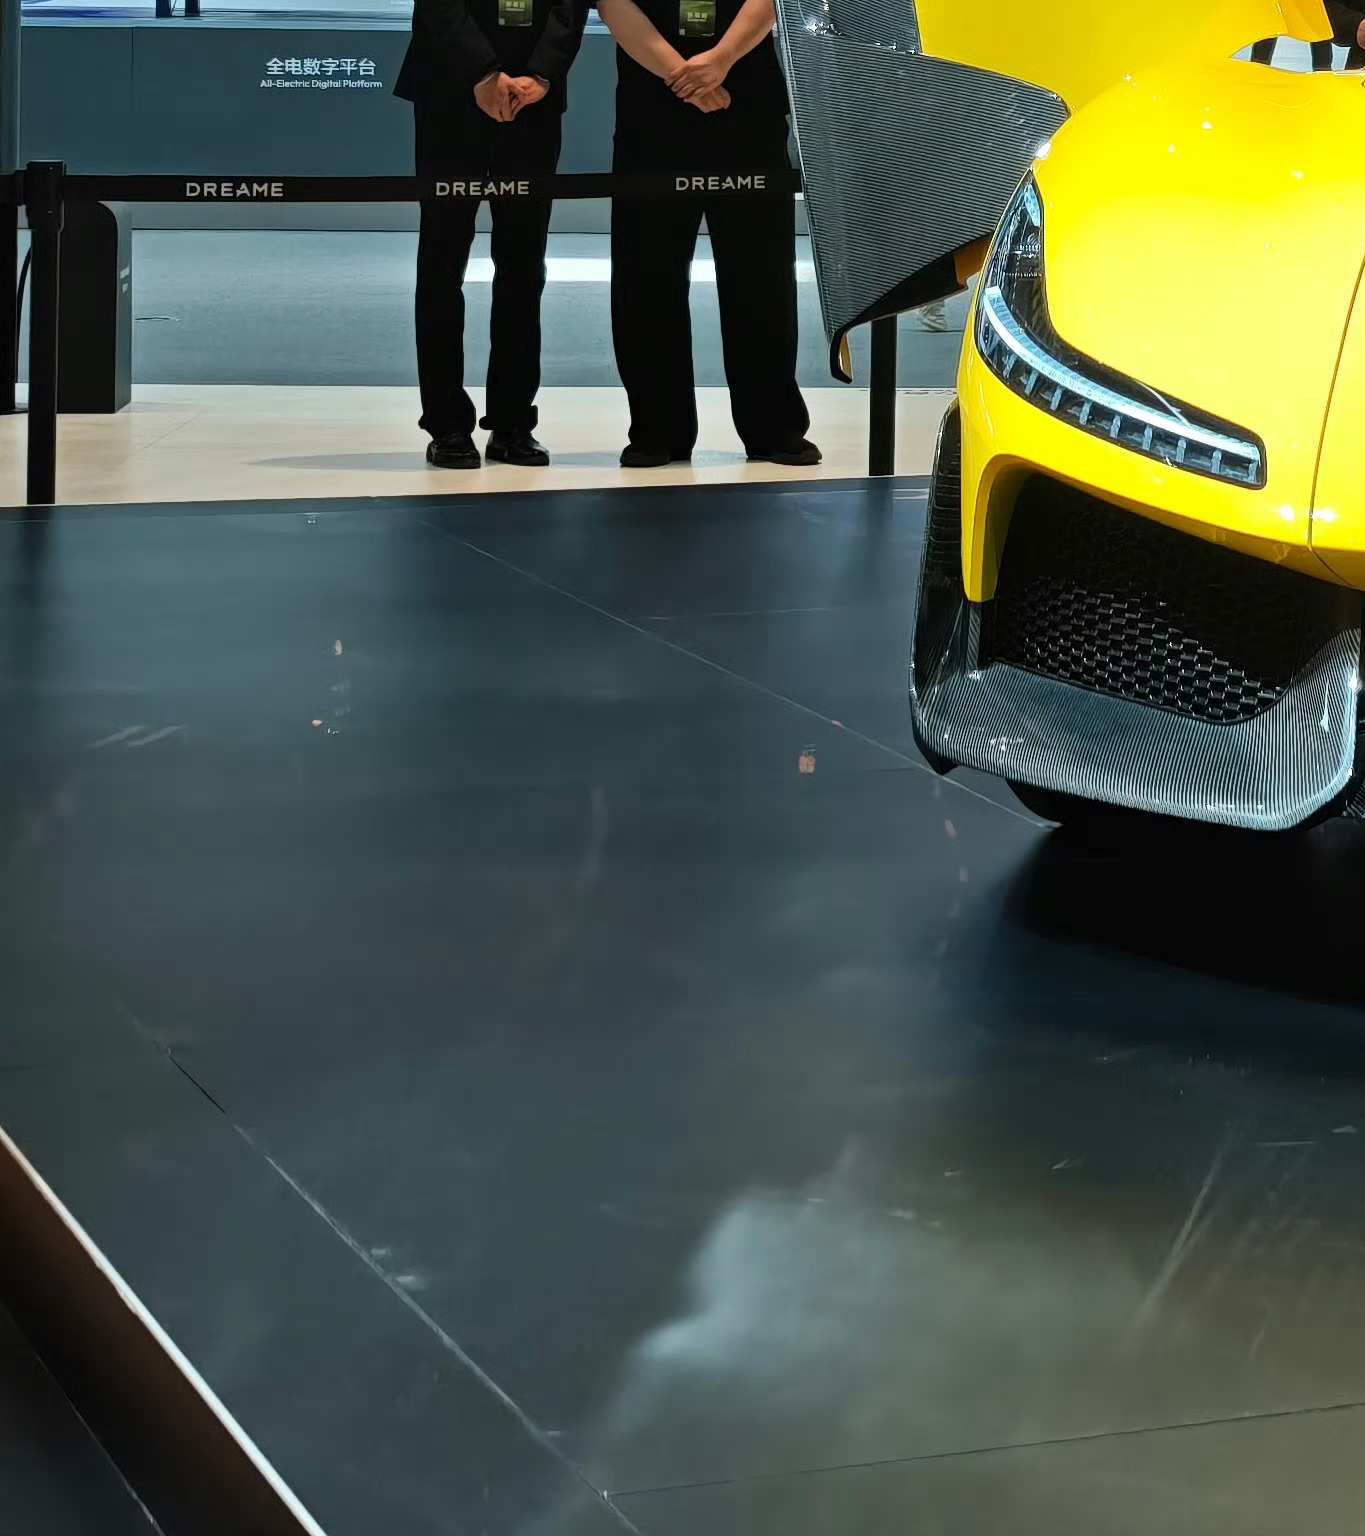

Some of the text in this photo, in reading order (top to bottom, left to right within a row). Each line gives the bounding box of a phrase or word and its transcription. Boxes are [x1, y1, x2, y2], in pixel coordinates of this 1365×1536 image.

[266, 58, 377, 76] 全电数字平台
[260, 79, 383, 89] All-Electric Digital Platform
[185, 182, 284, 197] DREAME
[435, 180, 530, 196] DREAME
[675, 175, 766, 191] DREAME
